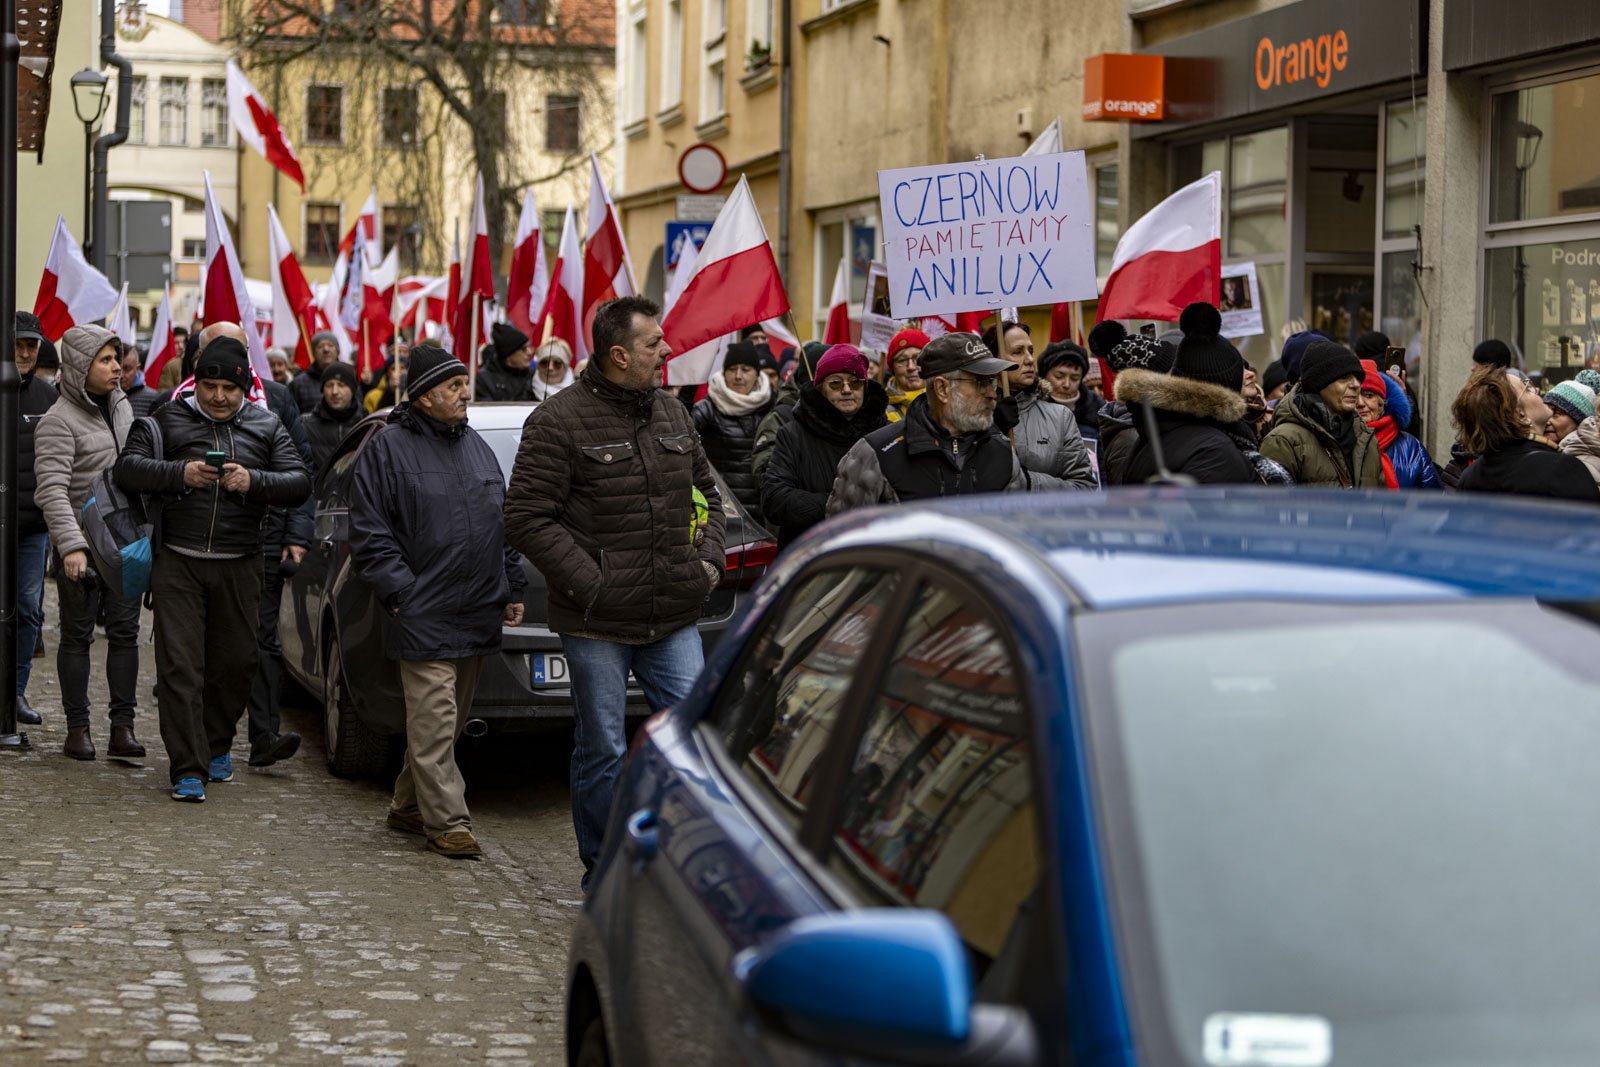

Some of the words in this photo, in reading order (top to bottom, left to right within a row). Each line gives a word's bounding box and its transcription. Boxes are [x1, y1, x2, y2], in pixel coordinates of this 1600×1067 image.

[1255, 29, 1348, 90] Orange
[1104, 99, 1157, 116] orange
[893, 162, 1061, 227] CZERNOW
[906, 248, 1053, 305] ANILUX
[534, 671, 544, 679] PL
[549, 656, 566, 680] D
